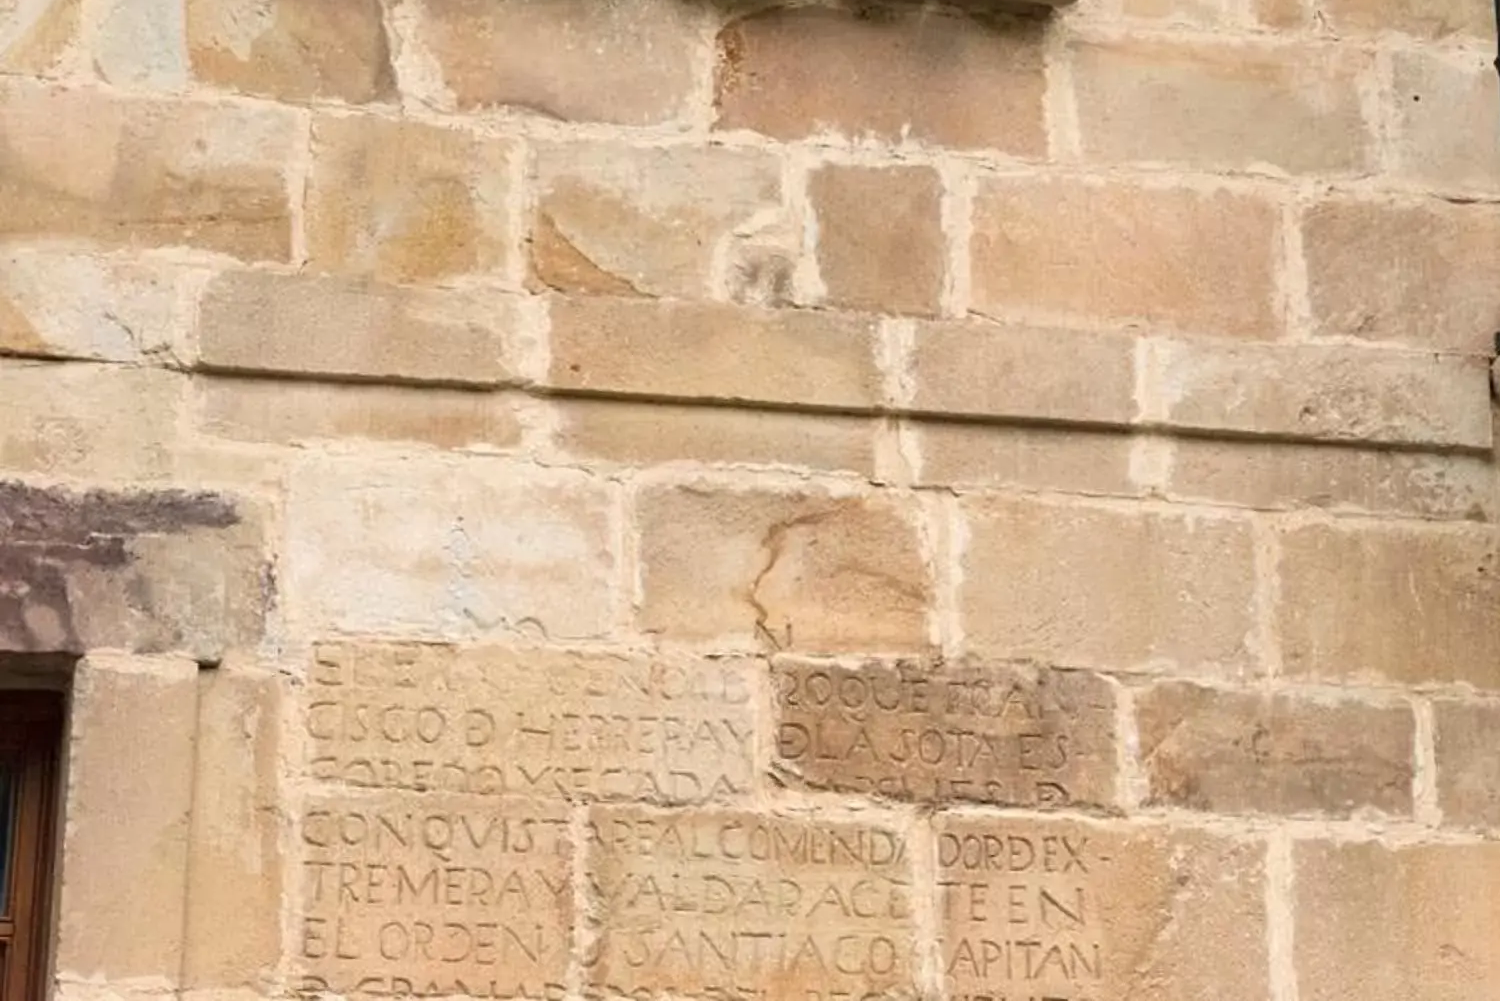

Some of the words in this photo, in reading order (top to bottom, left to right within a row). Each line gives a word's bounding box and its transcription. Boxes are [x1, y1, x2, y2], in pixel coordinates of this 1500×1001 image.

[783, 670, 929, 721] ROQUE
[1007, 883, 1086, 927] EN
[302, 916, 361, 960] EL
